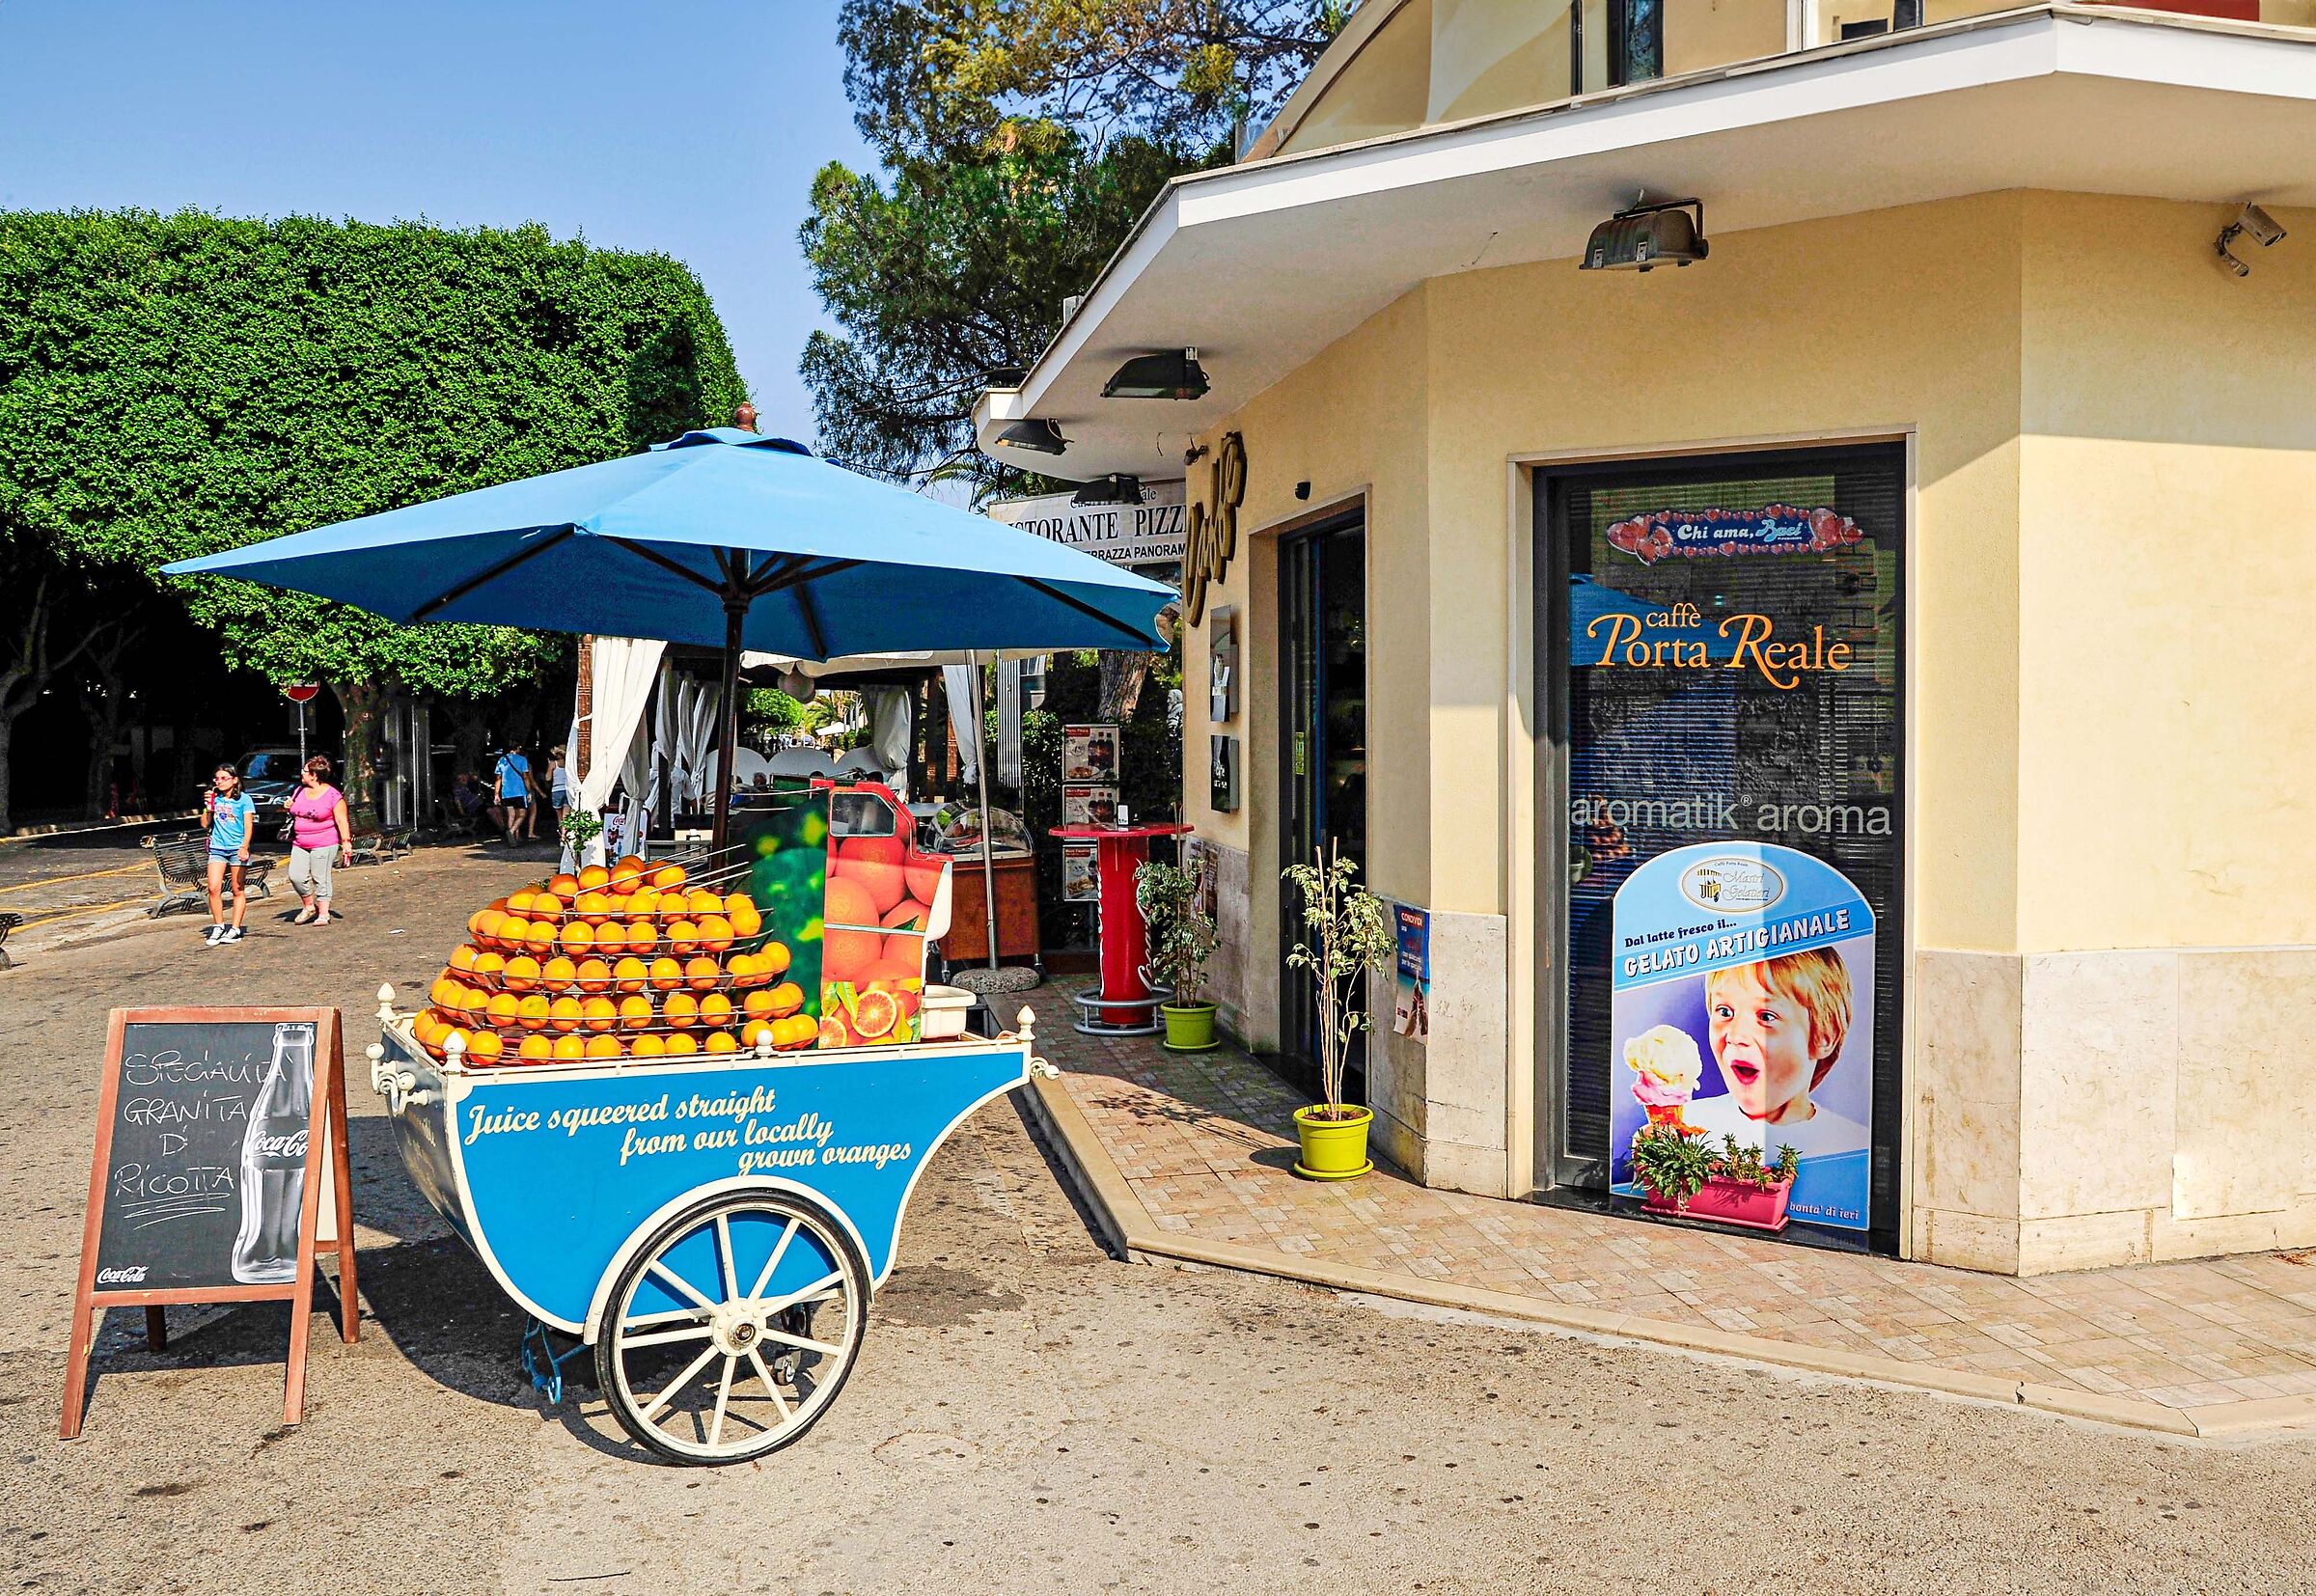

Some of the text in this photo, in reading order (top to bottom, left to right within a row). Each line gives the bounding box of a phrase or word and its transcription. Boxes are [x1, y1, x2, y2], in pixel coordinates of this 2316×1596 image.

[1677, 519, 1803, 544] Chi ama, Baci
[1645, 602, 1702, 629] caffè
[1586, 613, 1851, 690] Porta Reale
[1757, 804, 1892, 836] aroma
[1623, 909, 1851, 977] GELATO ARTIGIANALE
[1624, 934, 1644, 948] Dal
[1647, 931, 1675, 945] latte
[1677, 922, 1714, 939] fresco
[464, 1105, 540, 1145] Juice
[675, 1085, 777, 1126] straight
[619, 1113, 835, 1167] from our locally
[737, 1142, 913, 1176] grown oranges
[114, 1163, 235, 1197] RICOTTA
[1825, 1206, 1836, 1218] di
[1838, 1208, 1860, 1220] ieri
